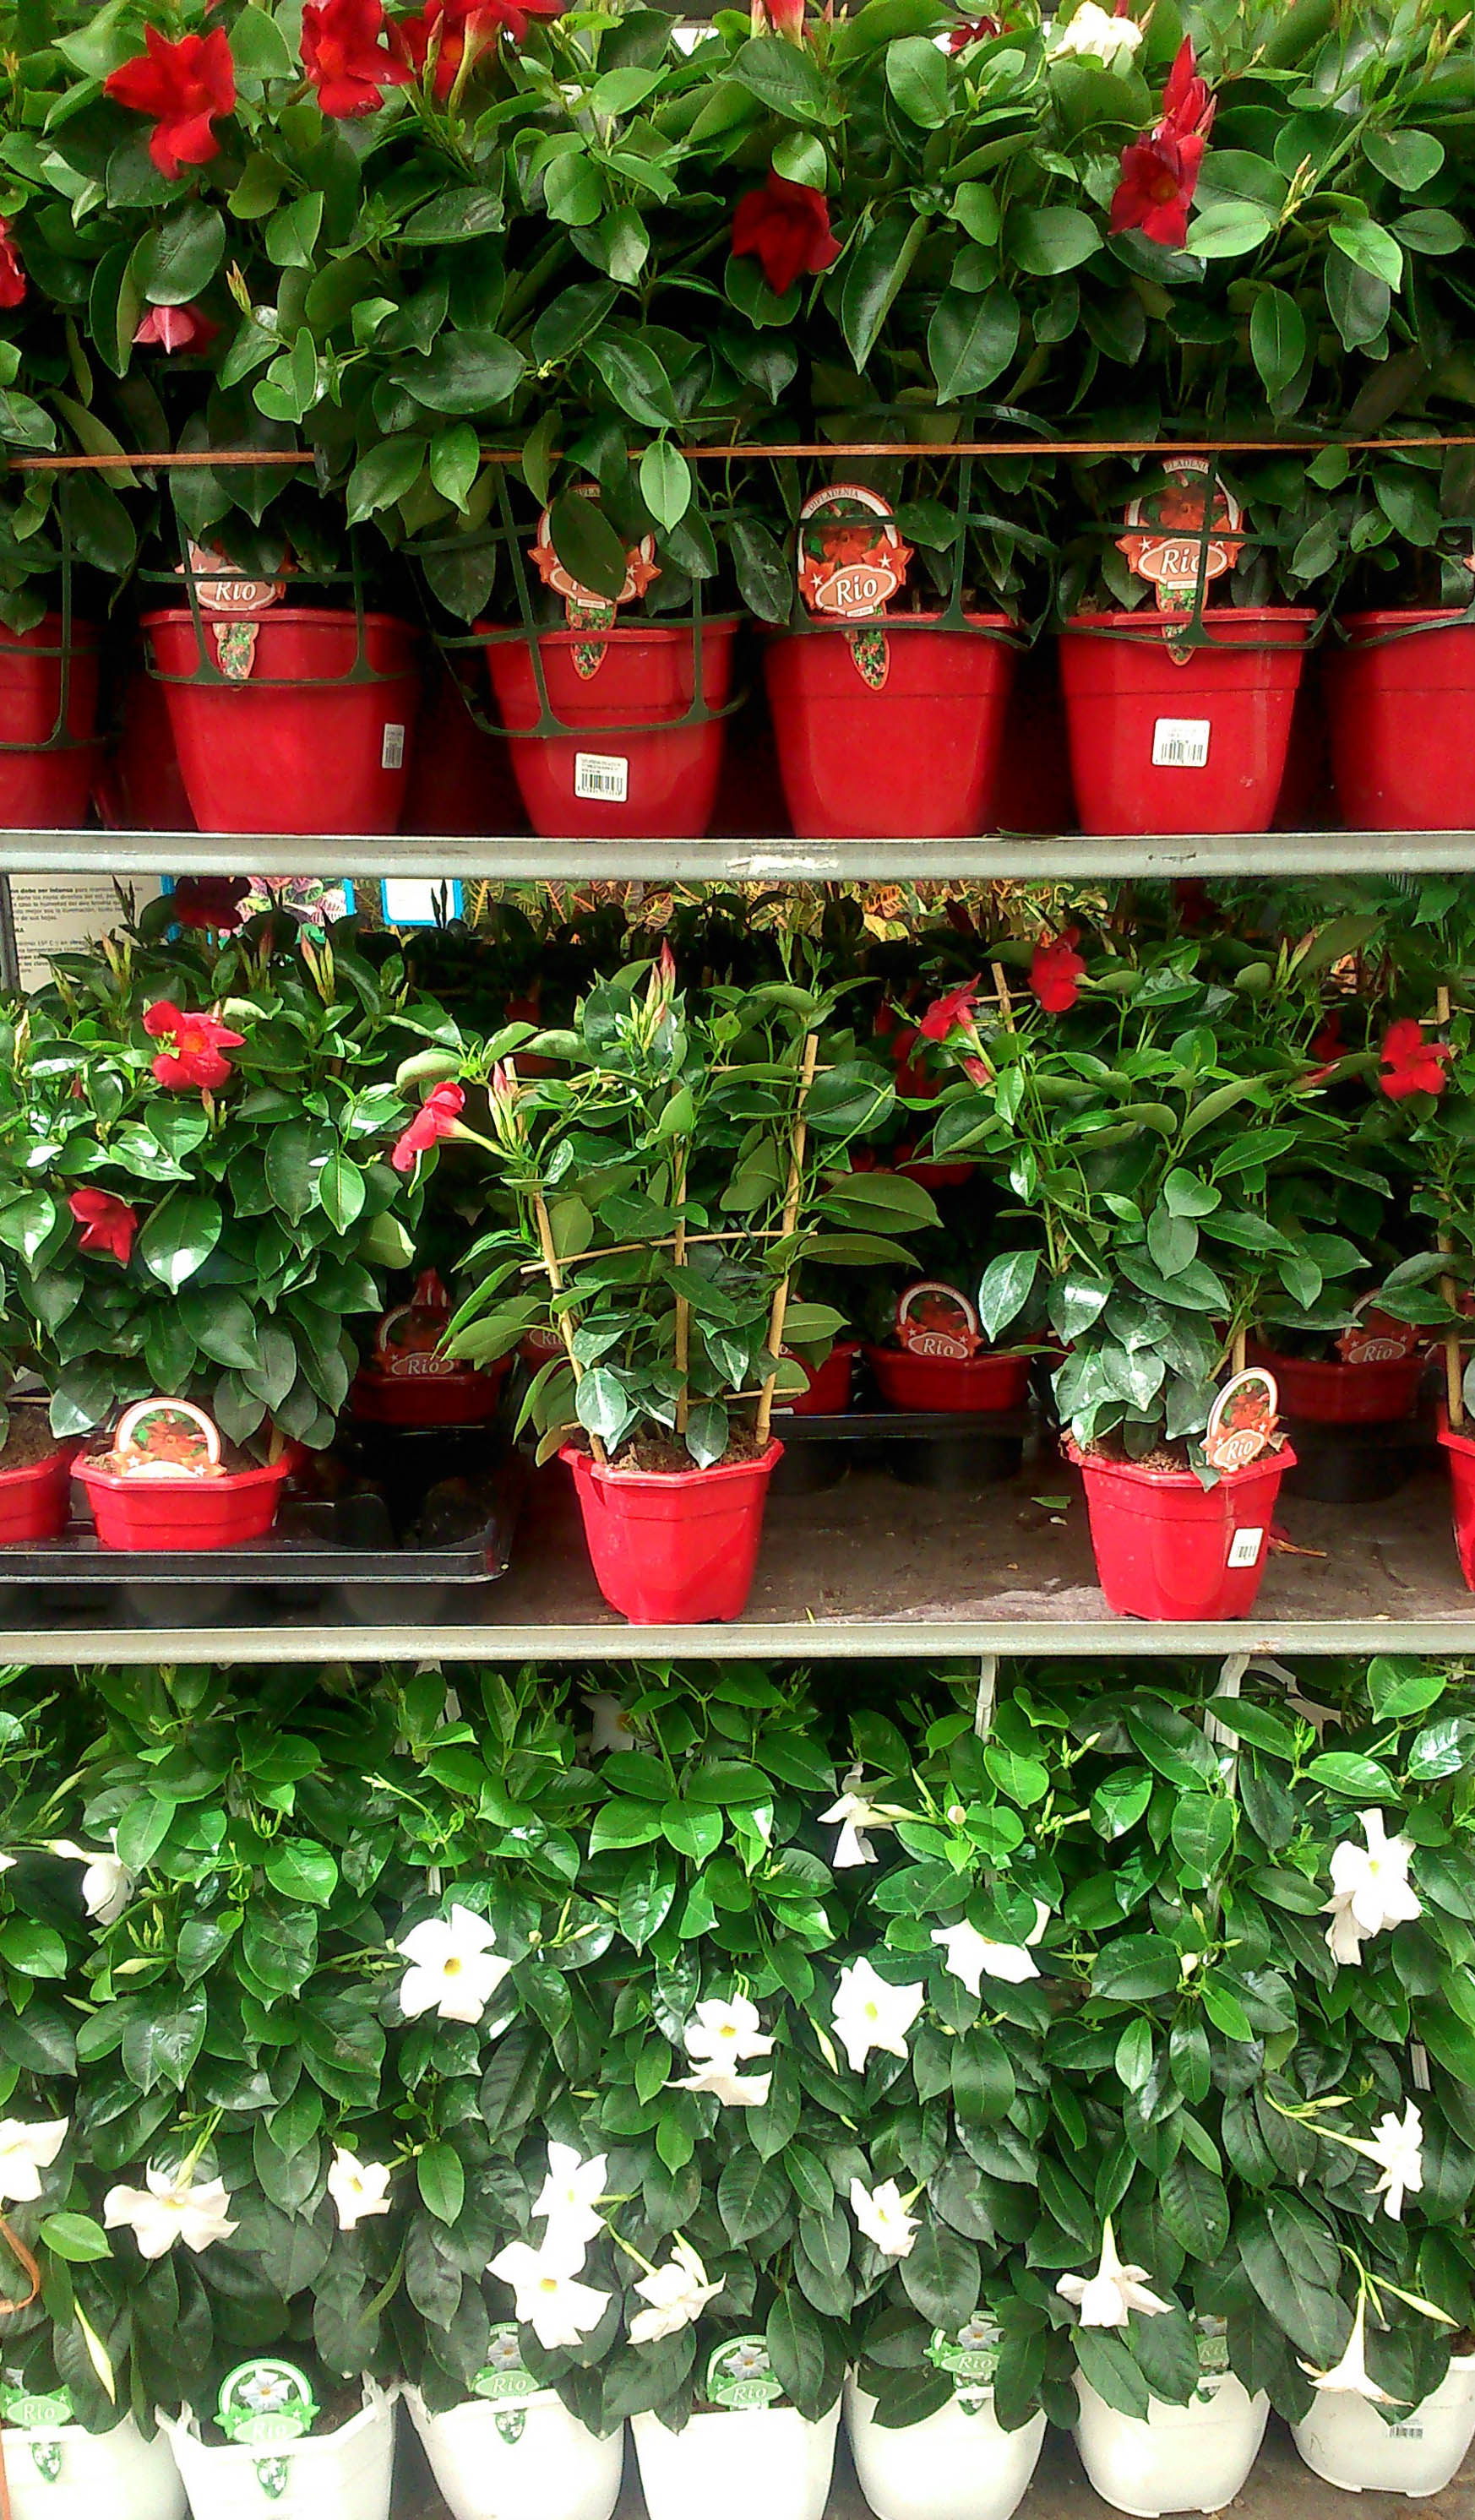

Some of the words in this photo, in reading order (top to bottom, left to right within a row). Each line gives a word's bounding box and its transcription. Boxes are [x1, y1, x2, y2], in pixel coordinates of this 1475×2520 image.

[807, 488, 859, 512] DIPLADENIA
[215, 580, 257, 601] Rio
[835, 574, 878, 606] Rio
[542, 1331, 563, 1344] Ri
[923, 1338, 954, 1357] Rio
[1363, 1344, 1393, 1362] Rio
[407, 1358, 440, 1375] Rio
[1227, 1437, 1254, 1461] Rio
[958, 2356, 993, 2370] Rio
[493, 2376, 526, 2393] Rio
[732, 2385, 767, 2402] Rio
[23, 2403, 56, 2421] Rio
[253, 2420, 287, 2440] Rio
